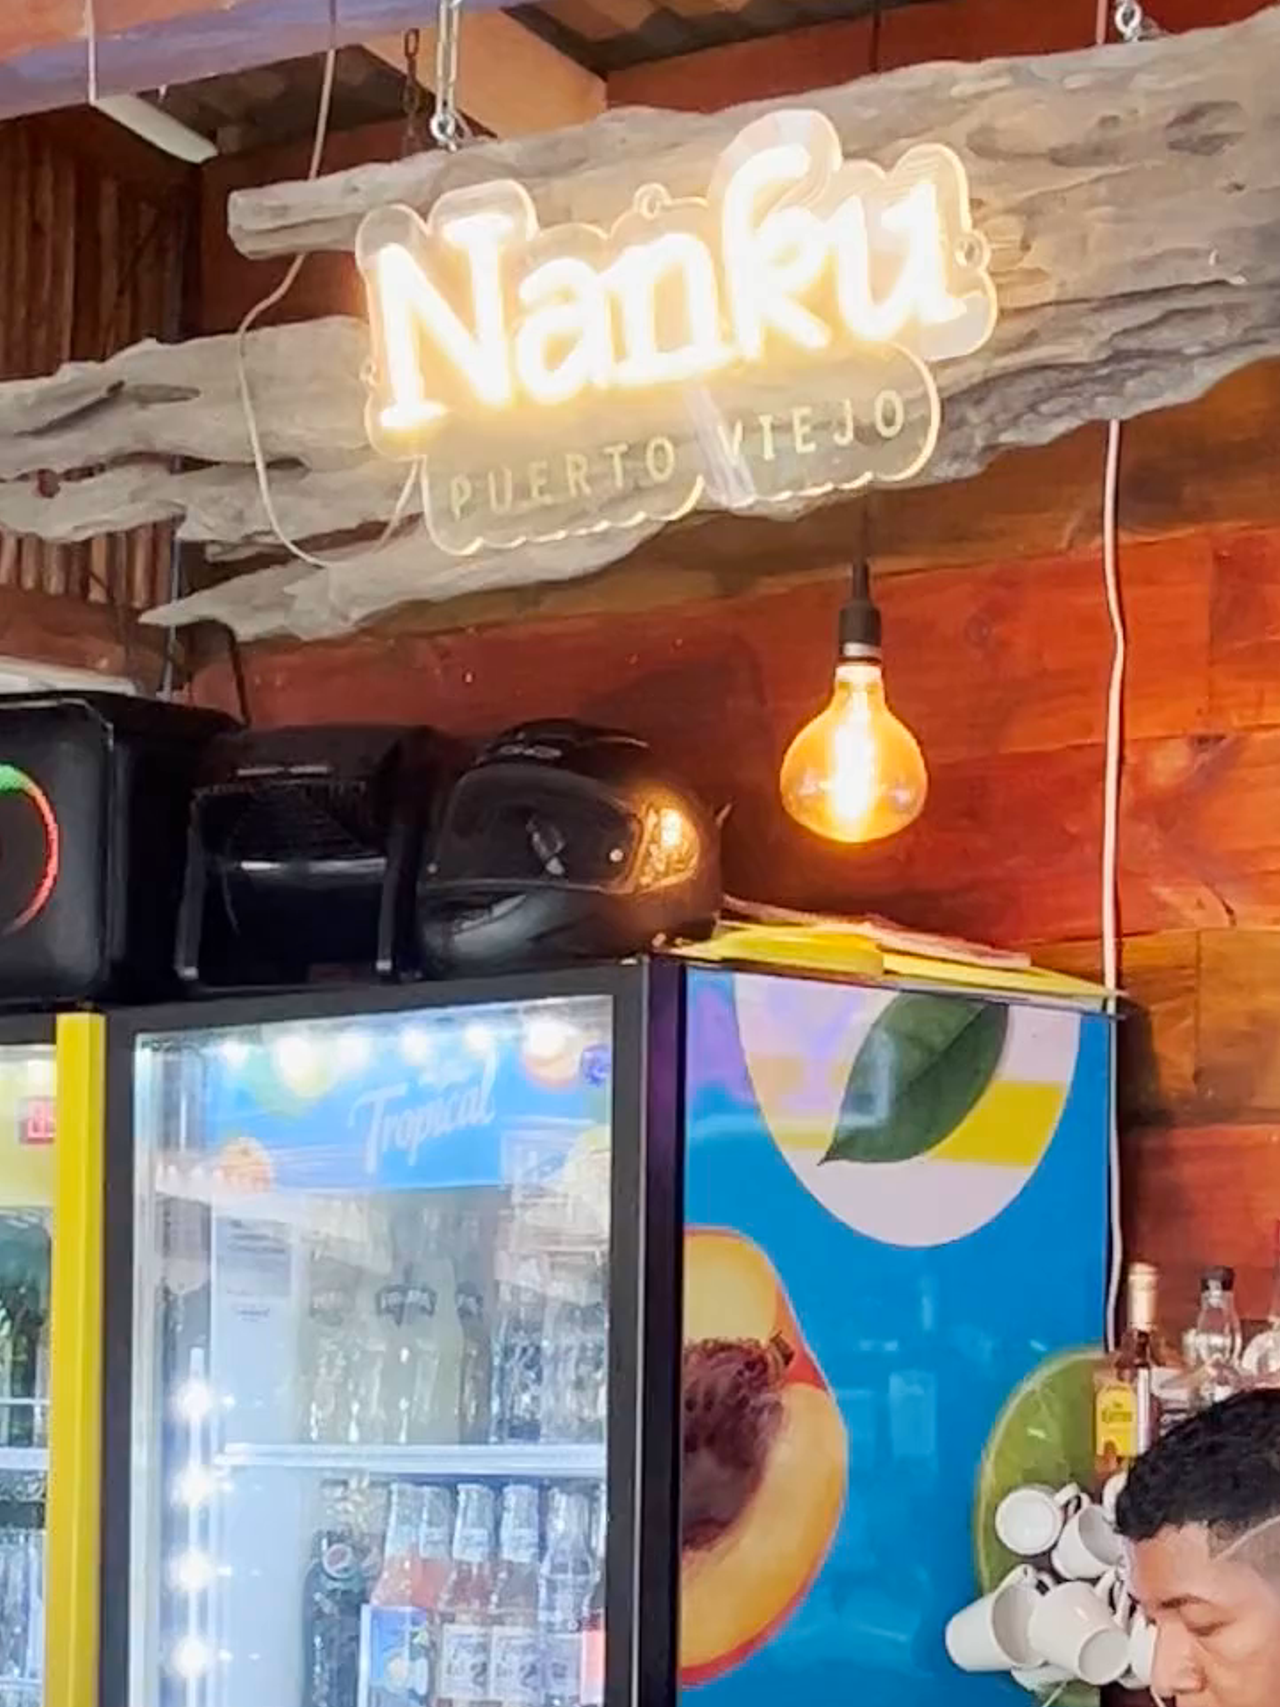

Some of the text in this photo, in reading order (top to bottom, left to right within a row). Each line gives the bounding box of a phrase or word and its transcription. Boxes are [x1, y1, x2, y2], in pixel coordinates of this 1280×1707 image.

[376, 139, 968, 431] Nanku
[450, 389, 906, 521] PUERTO VIEJO
[347, 1049, 499, 1175] Tropical
